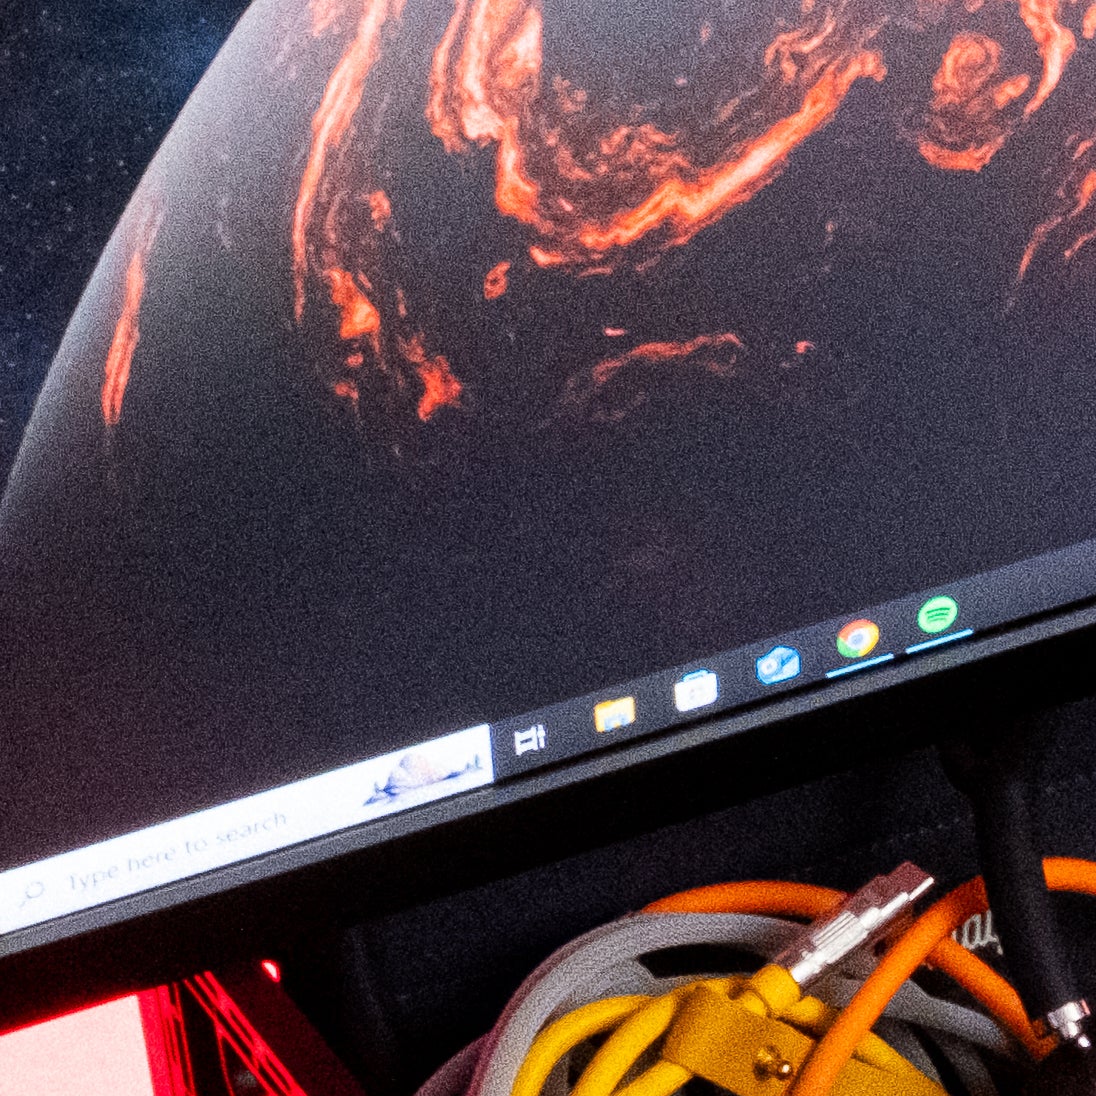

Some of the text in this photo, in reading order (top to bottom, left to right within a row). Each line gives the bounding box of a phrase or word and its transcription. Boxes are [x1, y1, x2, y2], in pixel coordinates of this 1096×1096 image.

[69, 812, 287, 892] Type here to search
